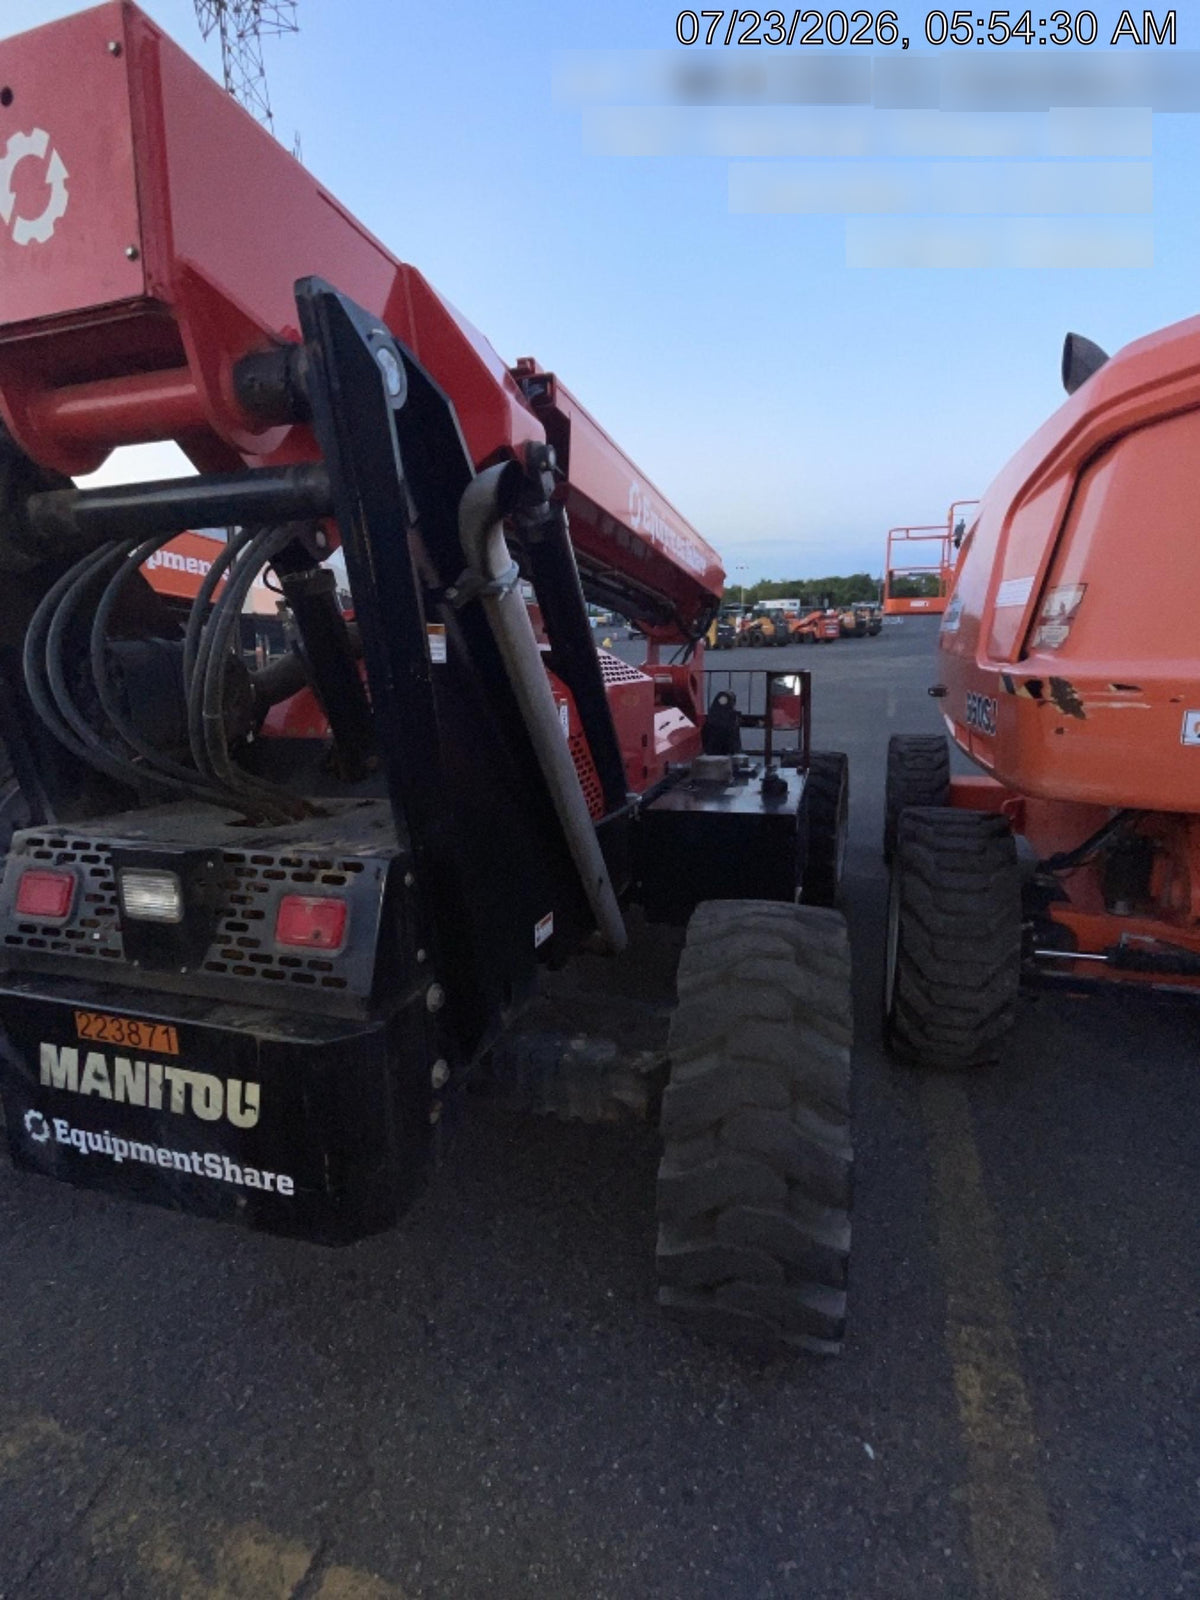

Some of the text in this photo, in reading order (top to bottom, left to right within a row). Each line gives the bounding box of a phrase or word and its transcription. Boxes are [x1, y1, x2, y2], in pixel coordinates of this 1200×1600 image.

[77, 1012, 173, 1052] 223871
[40, 1041, 260, 1129] MANITOU
[52, 1117, 295, 1196] EquipmentShare
